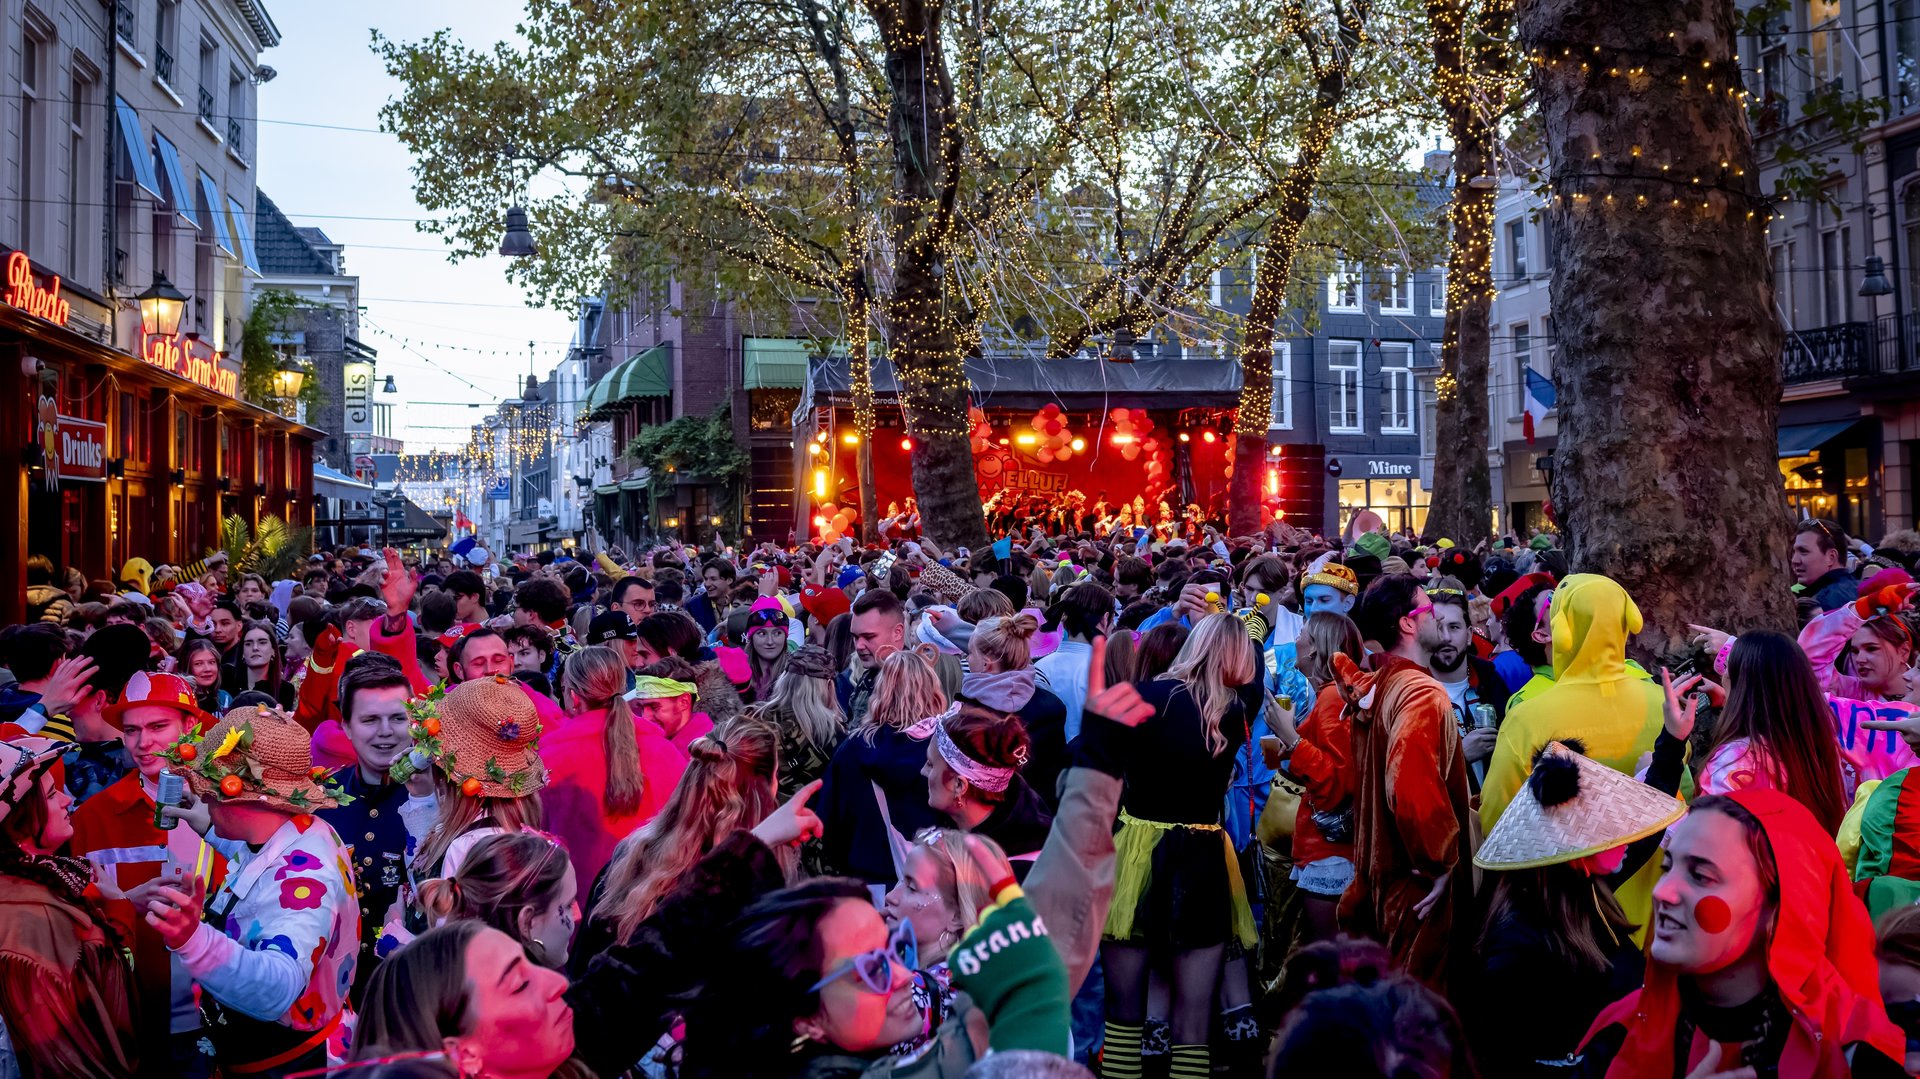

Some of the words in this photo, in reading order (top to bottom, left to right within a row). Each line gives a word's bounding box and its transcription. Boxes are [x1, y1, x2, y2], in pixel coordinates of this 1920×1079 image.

[346, 374, 366, 423] ellis
[62, 431, 102, 468] Drinks
[1368, 460, 1412, 475] Minre
